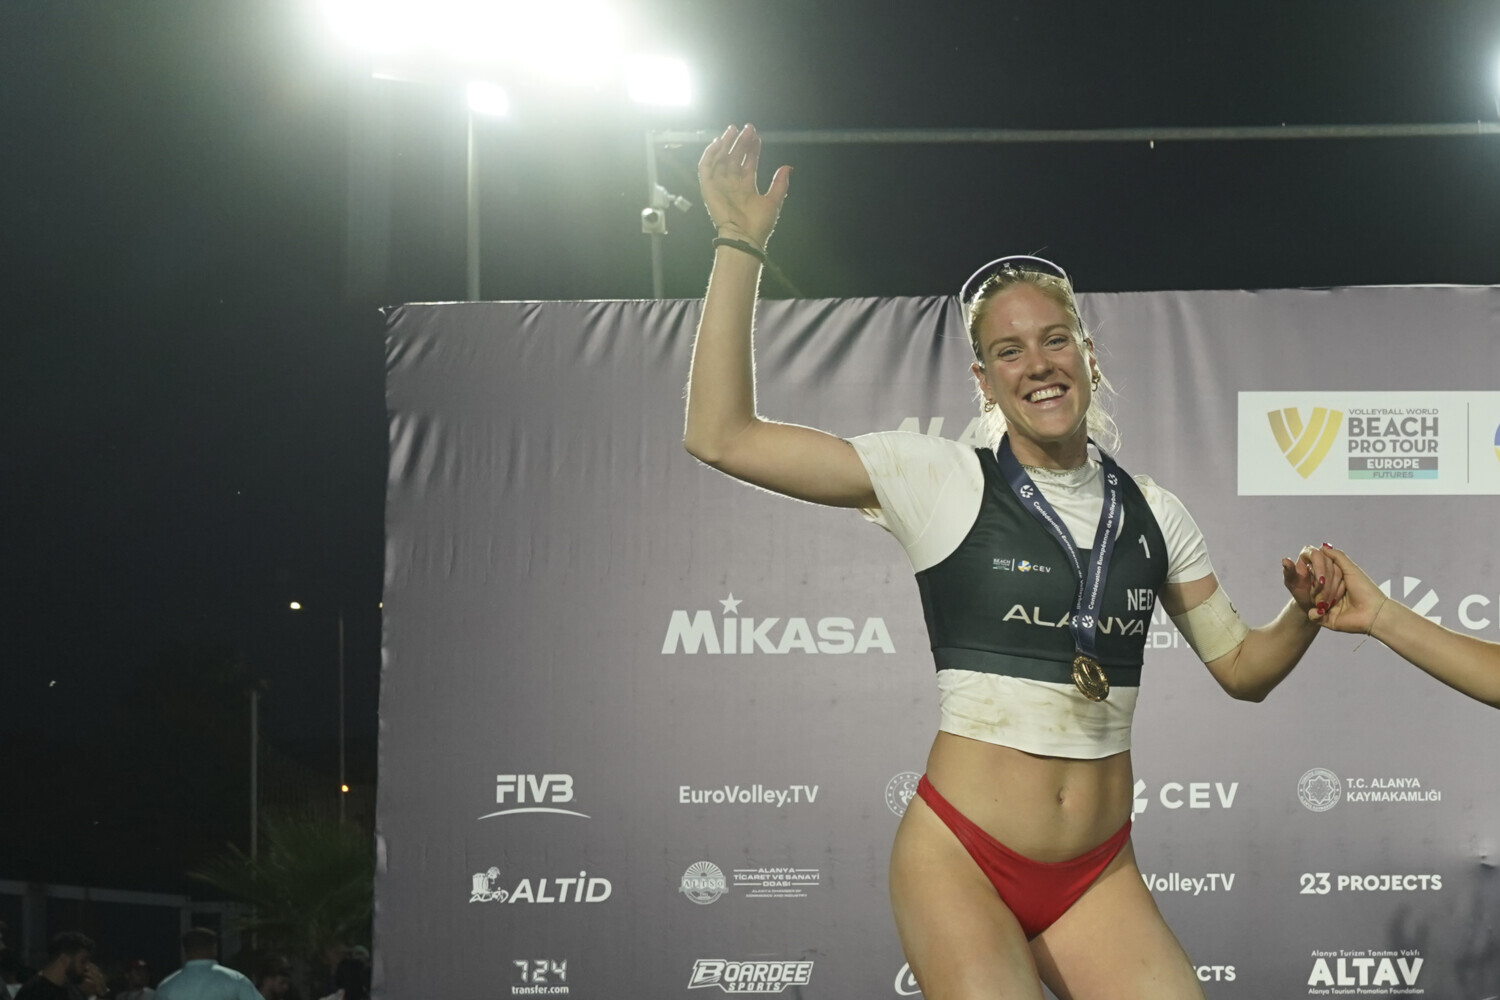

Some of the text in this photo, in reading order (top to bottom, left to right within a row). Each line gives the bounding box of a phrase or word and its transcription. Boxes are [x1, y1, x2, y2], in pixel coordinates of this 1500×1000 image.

[1348, 417, 1439, 437] BEACH
[1348, 439, 1438, 453] PRO TOUR
[1366, 458, 1420, 469] EUROPE
[1373, 471, 1414, 479] FUTURES
[1138, 534, 1151, 559] 1
[1032, 565, 1051, 573] CEV
[1127, 588, 1154, 611] NED
[496, 774, 574, 803] FIVB
[1346, 778, 1421, 788] T.C. ALANYA
[679, 784, 819, 807] EuroVolley.TV
[1159, 782, 1239, 808] CEV
[1346, 789, 1442, 802] KAYMAKAMLIĞI
[508, 870, 612, 903] ALTİD
[1141, 872, 1236, 896] Volley.TV
[1300, 872, 1442, 895] 23 PROJECTS
[1311, 950, 1337, 958] Alanya
[513, 960, 567, 982] 724
[693, 962, 810, 984] BOARDEE
[1307, 958, 1424, 986] ALTAV
[512, 985, 569, 995] transfer.com
[728, 983, 781, 991] SPORTS
